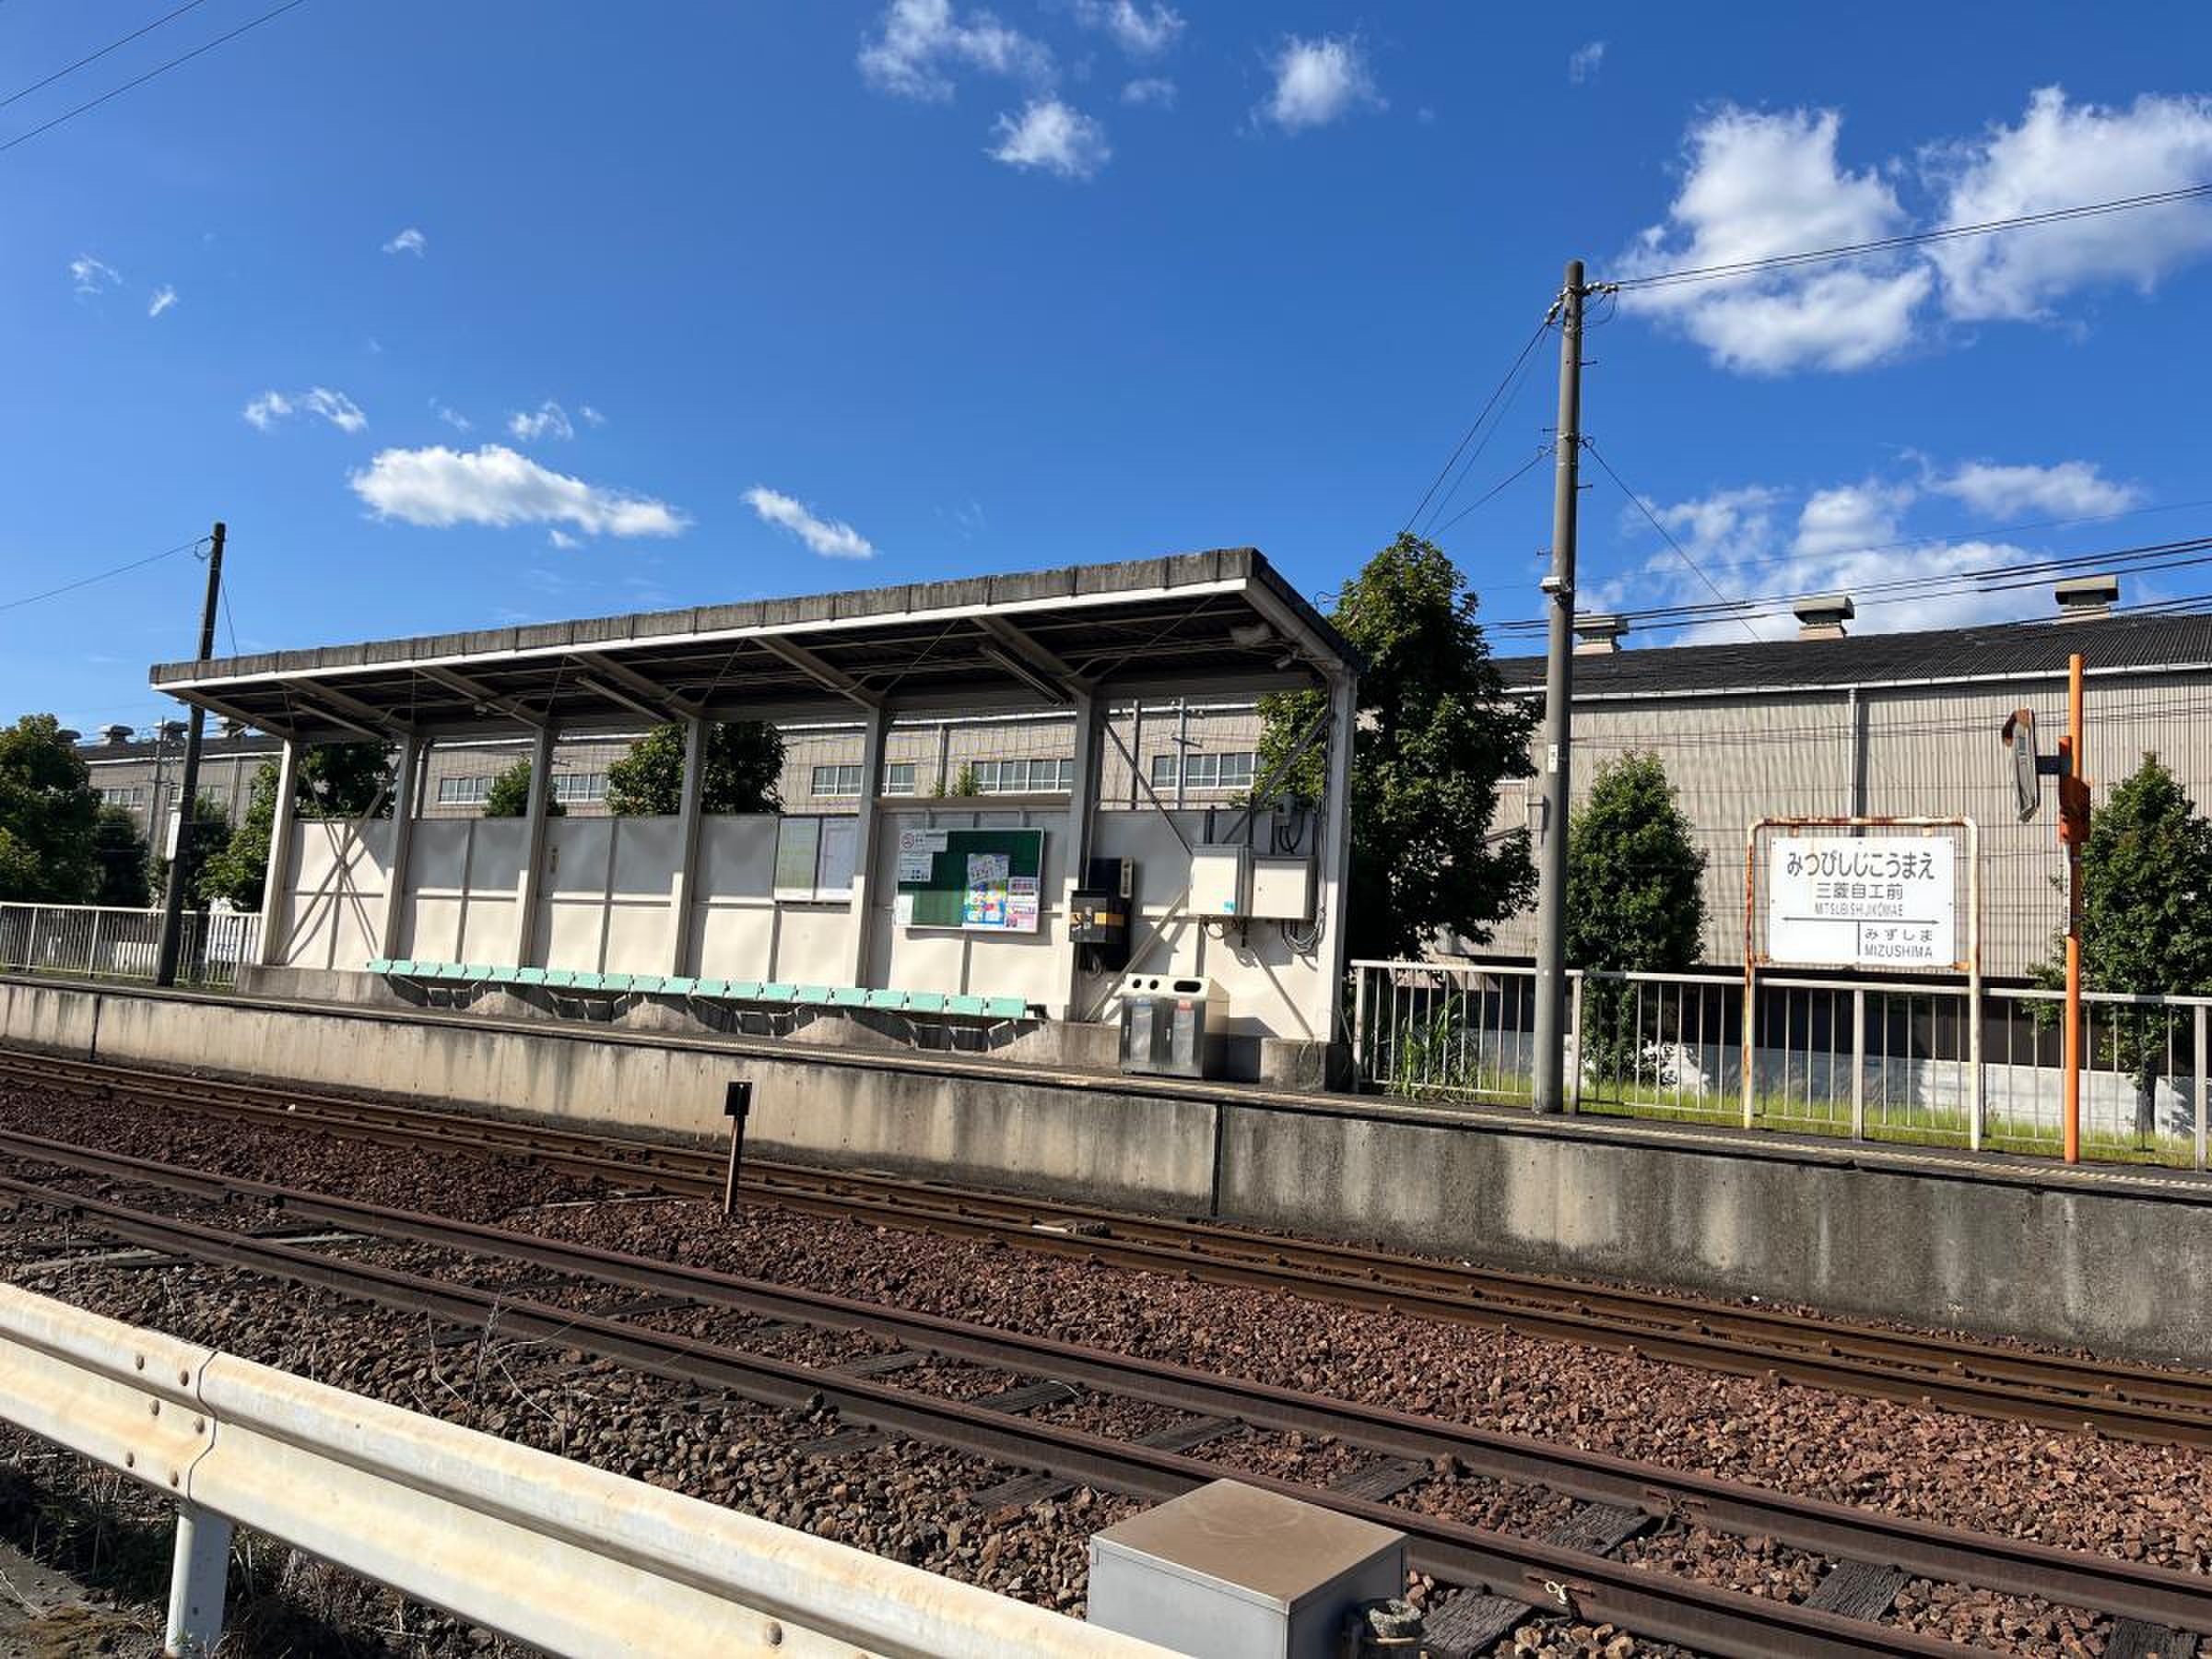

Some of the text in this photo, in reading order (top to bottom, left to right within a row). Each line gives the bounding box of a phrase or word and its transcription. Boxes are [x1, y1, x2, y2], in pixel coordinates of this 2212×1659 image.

[1787, 850, 1935, 880] みつびしじこうまえ
[1816, 882, 1903, 900] 三菱自工前
[1865, 928, 1933, 943] みずしま
[1865, 944, 1933, 959] MIZUSHIMA
